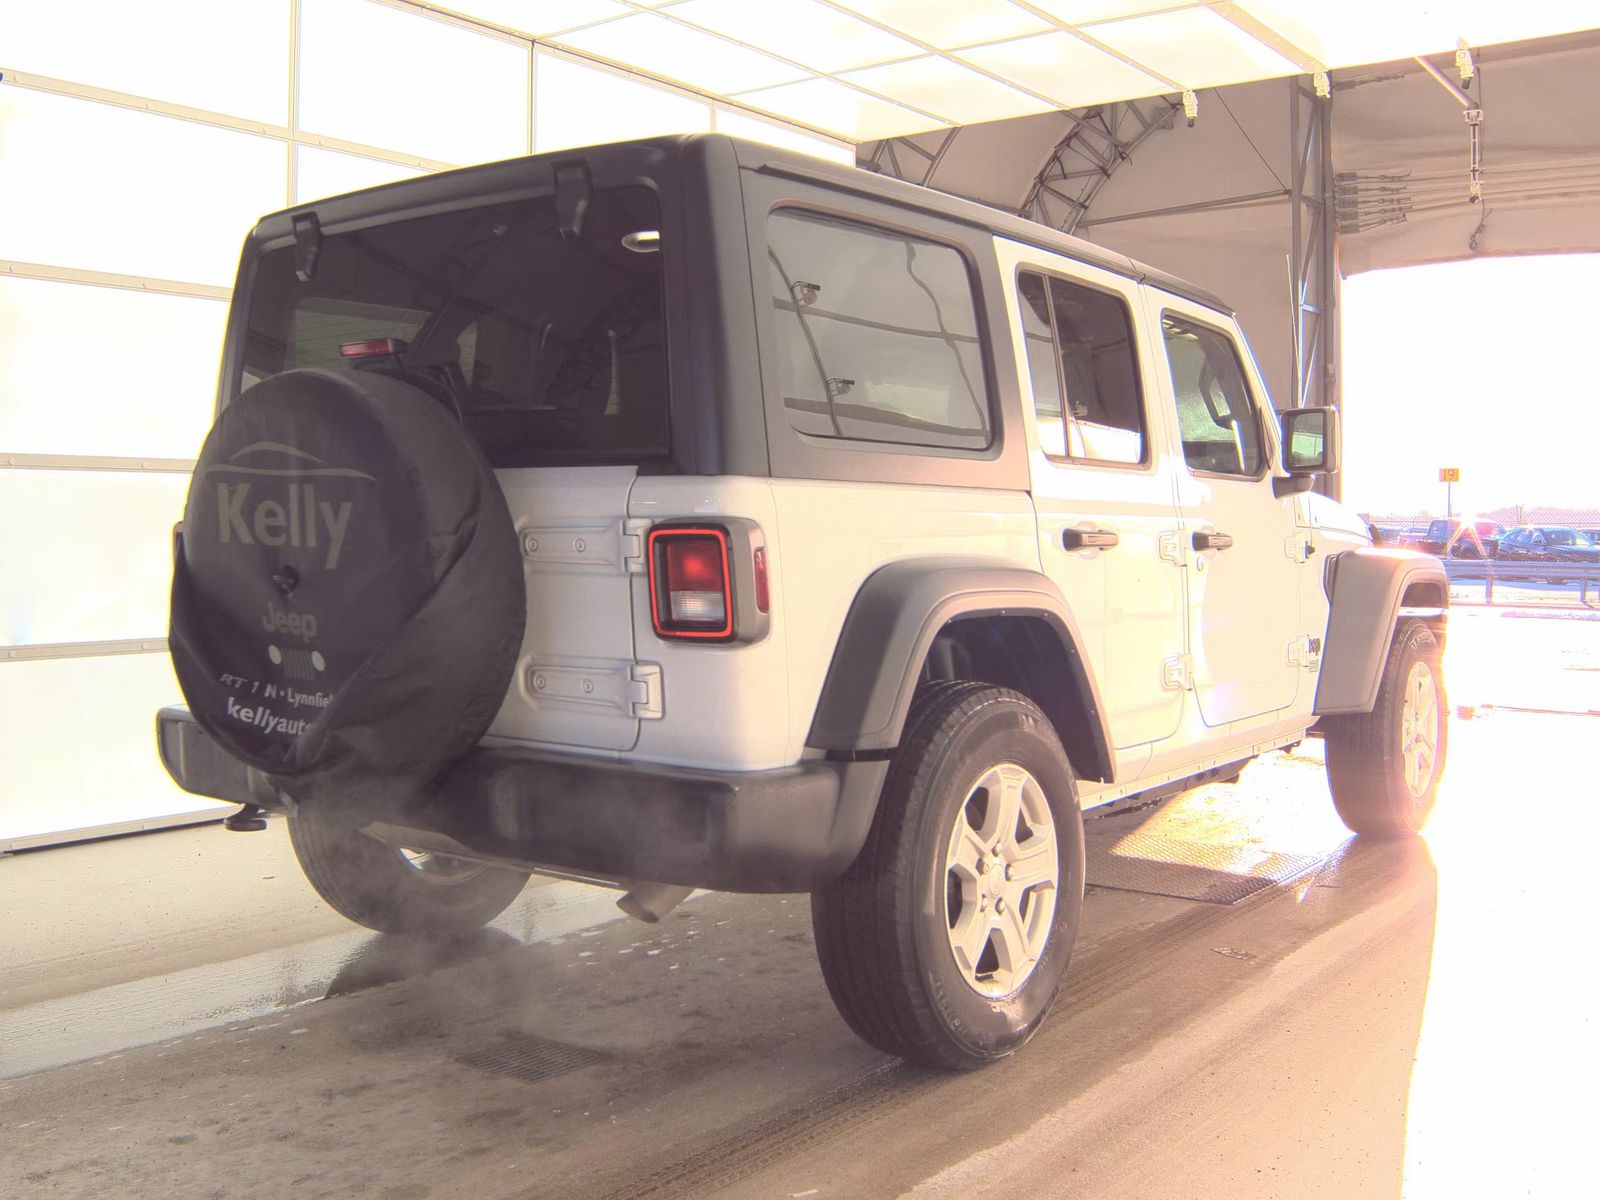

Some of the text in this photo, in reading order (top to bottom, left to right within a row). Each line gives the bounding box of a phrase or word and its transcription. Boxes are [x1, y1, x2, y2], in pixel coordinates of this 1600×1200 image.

[217, 482, 353, 570] Kelly
[261, 601, 317, 642] Jeep
[220, 673, 248, 688] RT
[251, 681, 260, 693] 1
[264, 683, 277, 699] N
